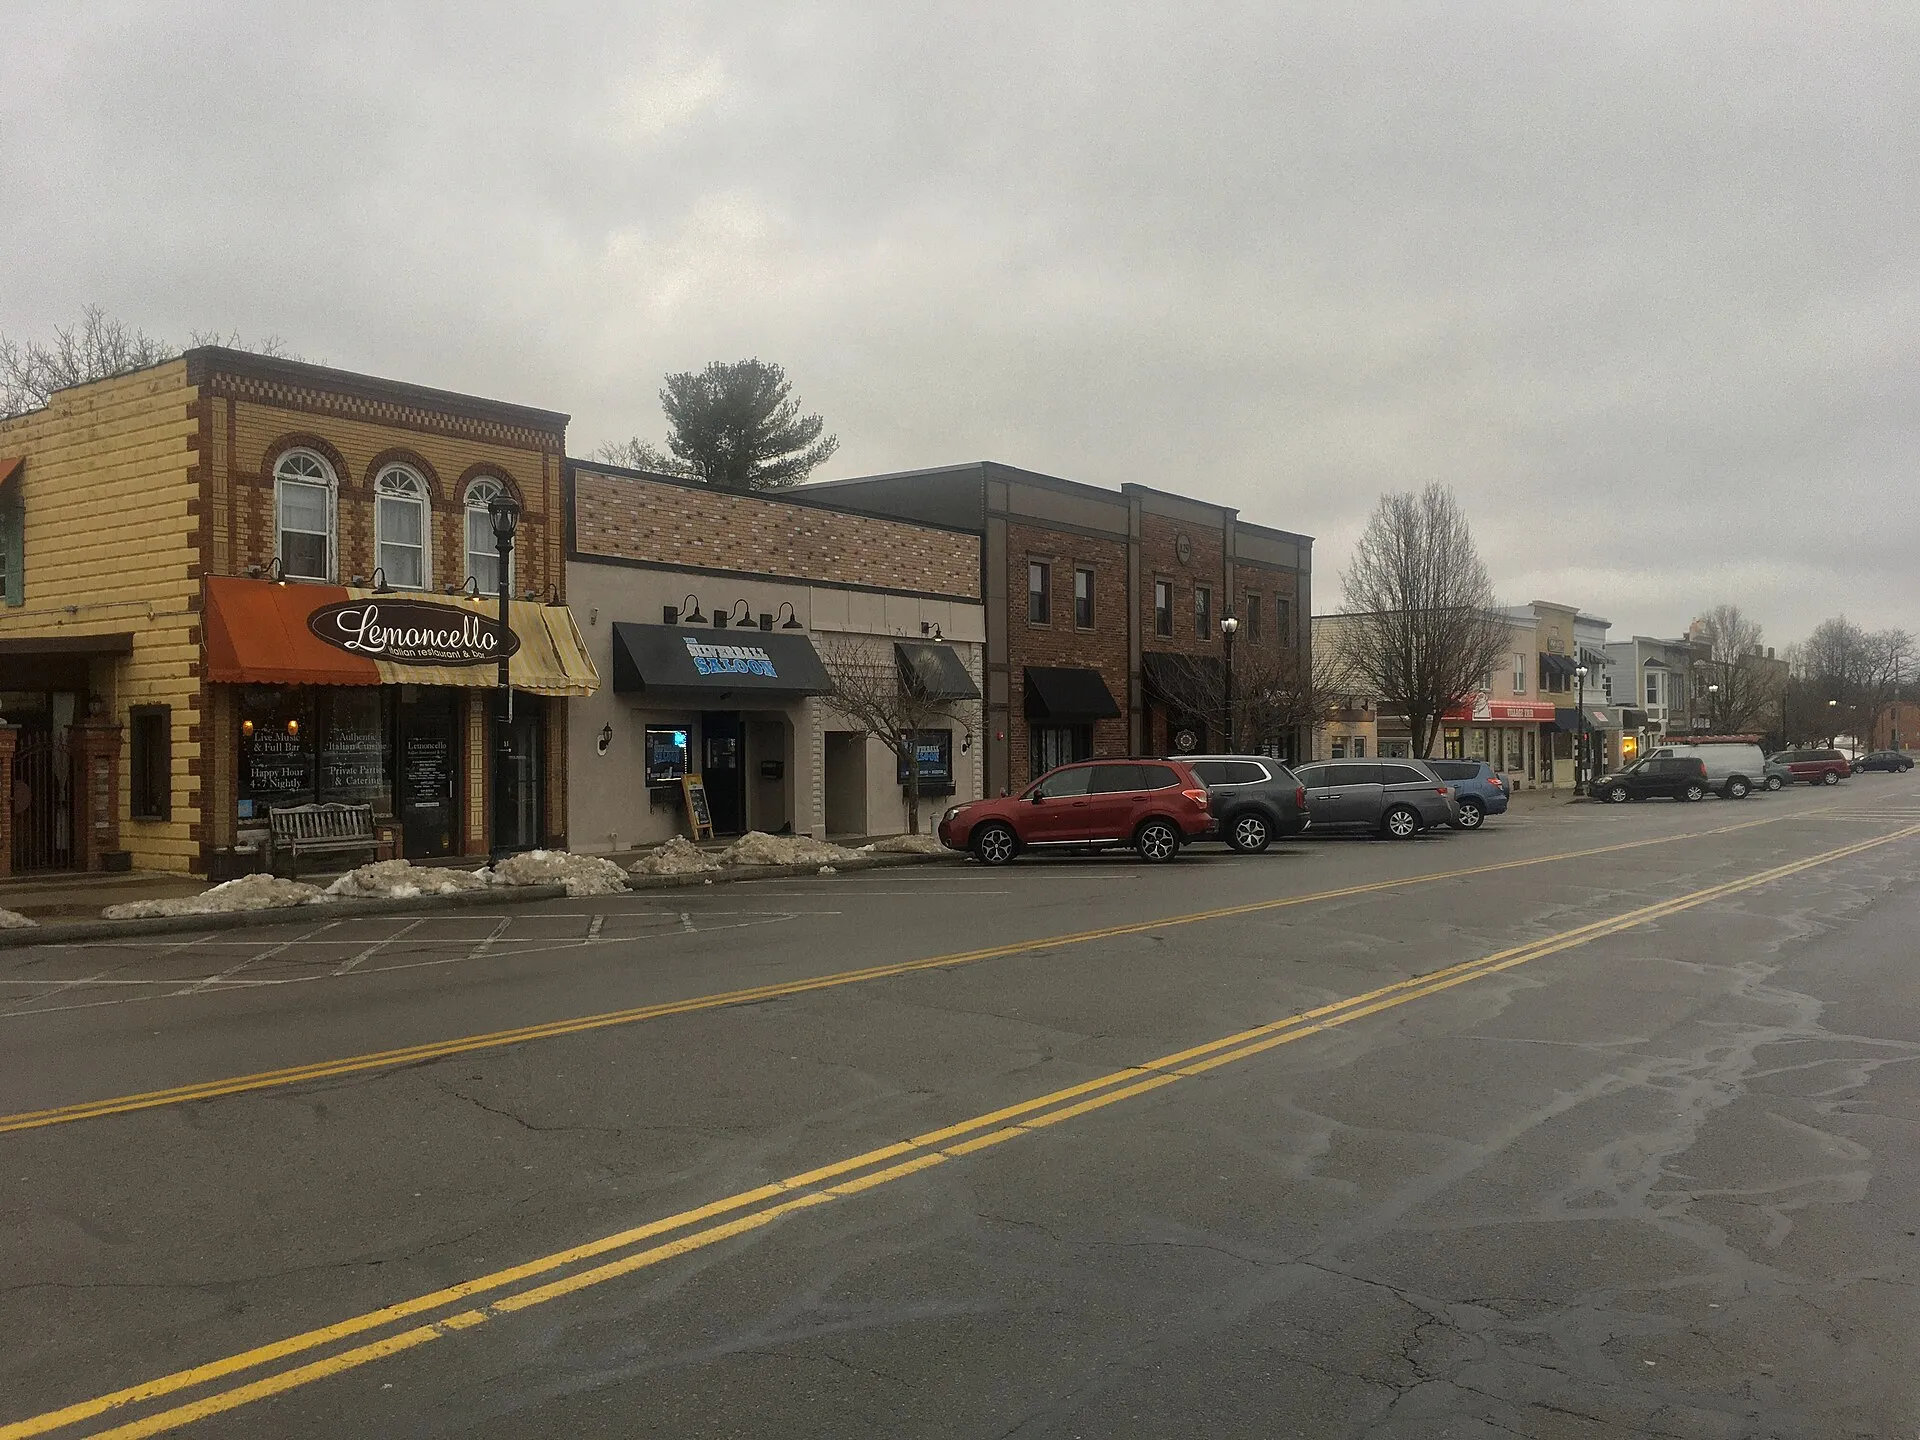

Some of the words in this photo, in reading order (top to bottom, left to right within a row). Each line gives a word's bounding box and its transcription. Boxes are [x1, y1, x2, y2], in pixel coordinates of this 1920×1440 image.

[336, 604, 498, 652] Lemoncello
[418, 647, 461, 659] restaurant
[462, 650, 471, 658] &
[694, 657, 778, 678] SALOON
[254, 742, 262, 752] &
[265, 742, 283, 752] Full
[285, 742, 300, 752] Bar
[329, 742, 355, 751] Italian
[408, 741, 447, 750] Lemoncello
[251, 768, 280, 781] Happy
[282, 767, 304, 777] Hour
[330, 766, 358, 775] Private
[269, 778, 302, 790] Nightly
[335, 776, 342, 786] &
